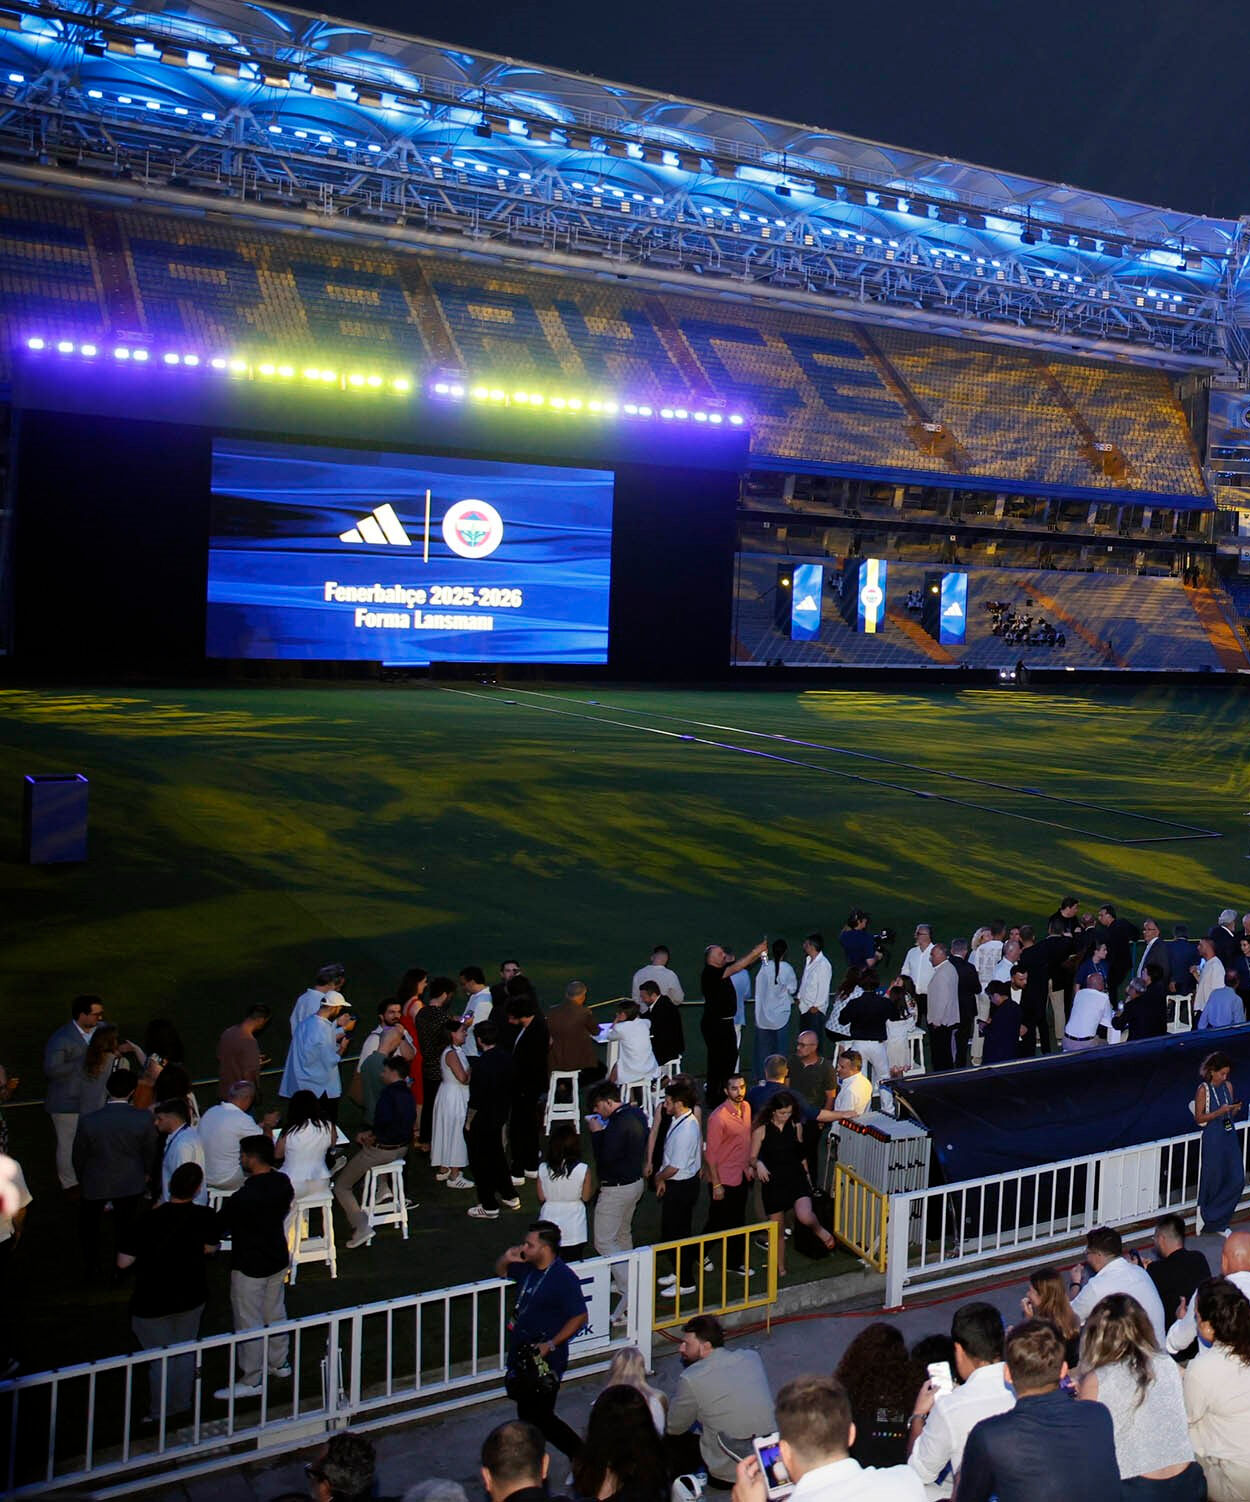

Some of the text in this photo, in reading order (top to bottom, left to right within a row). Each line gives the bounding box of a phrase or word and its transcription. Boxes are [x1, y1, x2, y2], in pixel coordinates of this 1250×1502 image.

[324, 582, 523, 608] Fenerbahçe 2025-2026
[354, 608, 410, 629] Forma
